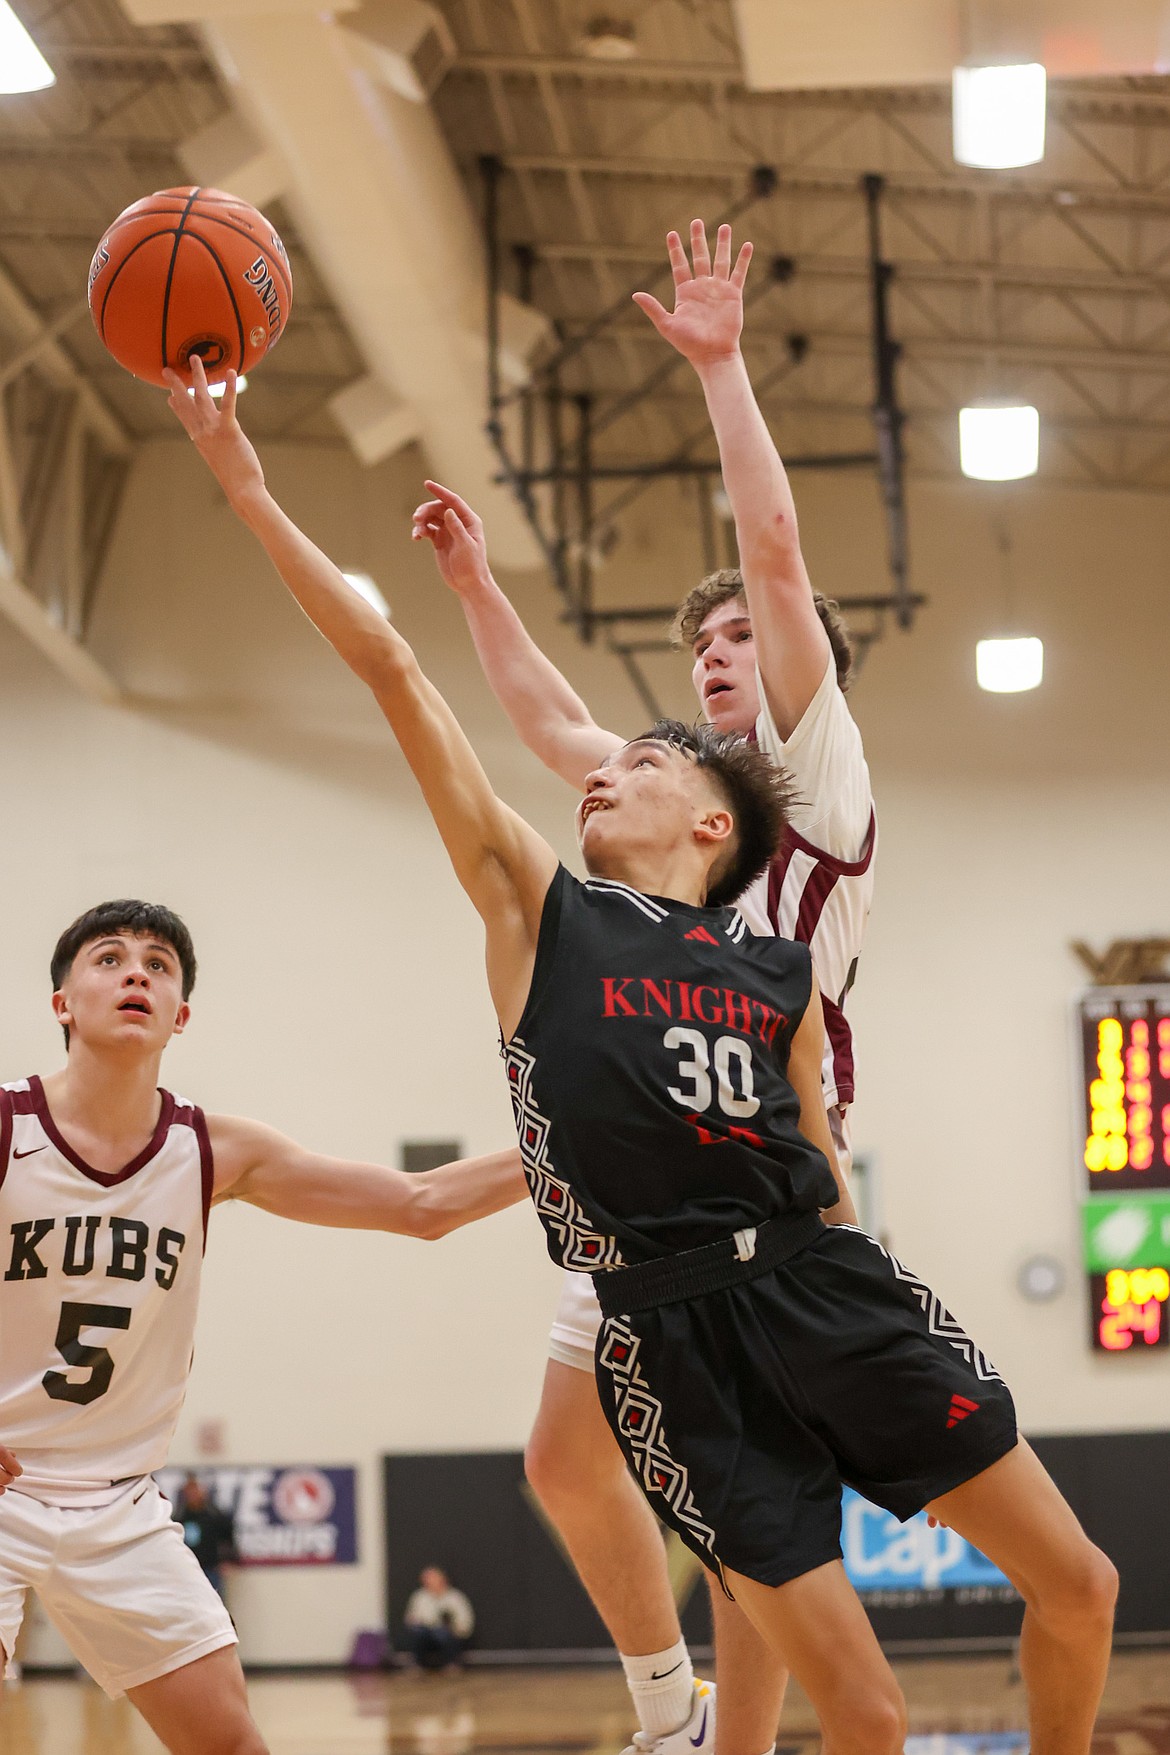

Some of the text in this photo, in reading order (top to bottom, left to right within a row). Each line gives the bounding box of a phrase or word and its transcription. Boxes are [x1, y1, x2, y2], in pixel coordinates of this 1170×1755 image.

[663, 1026, 761, 1119] 30
[4, 1215, 186, 1291] KUBS
[41, 1301, 132, 1406] 5
